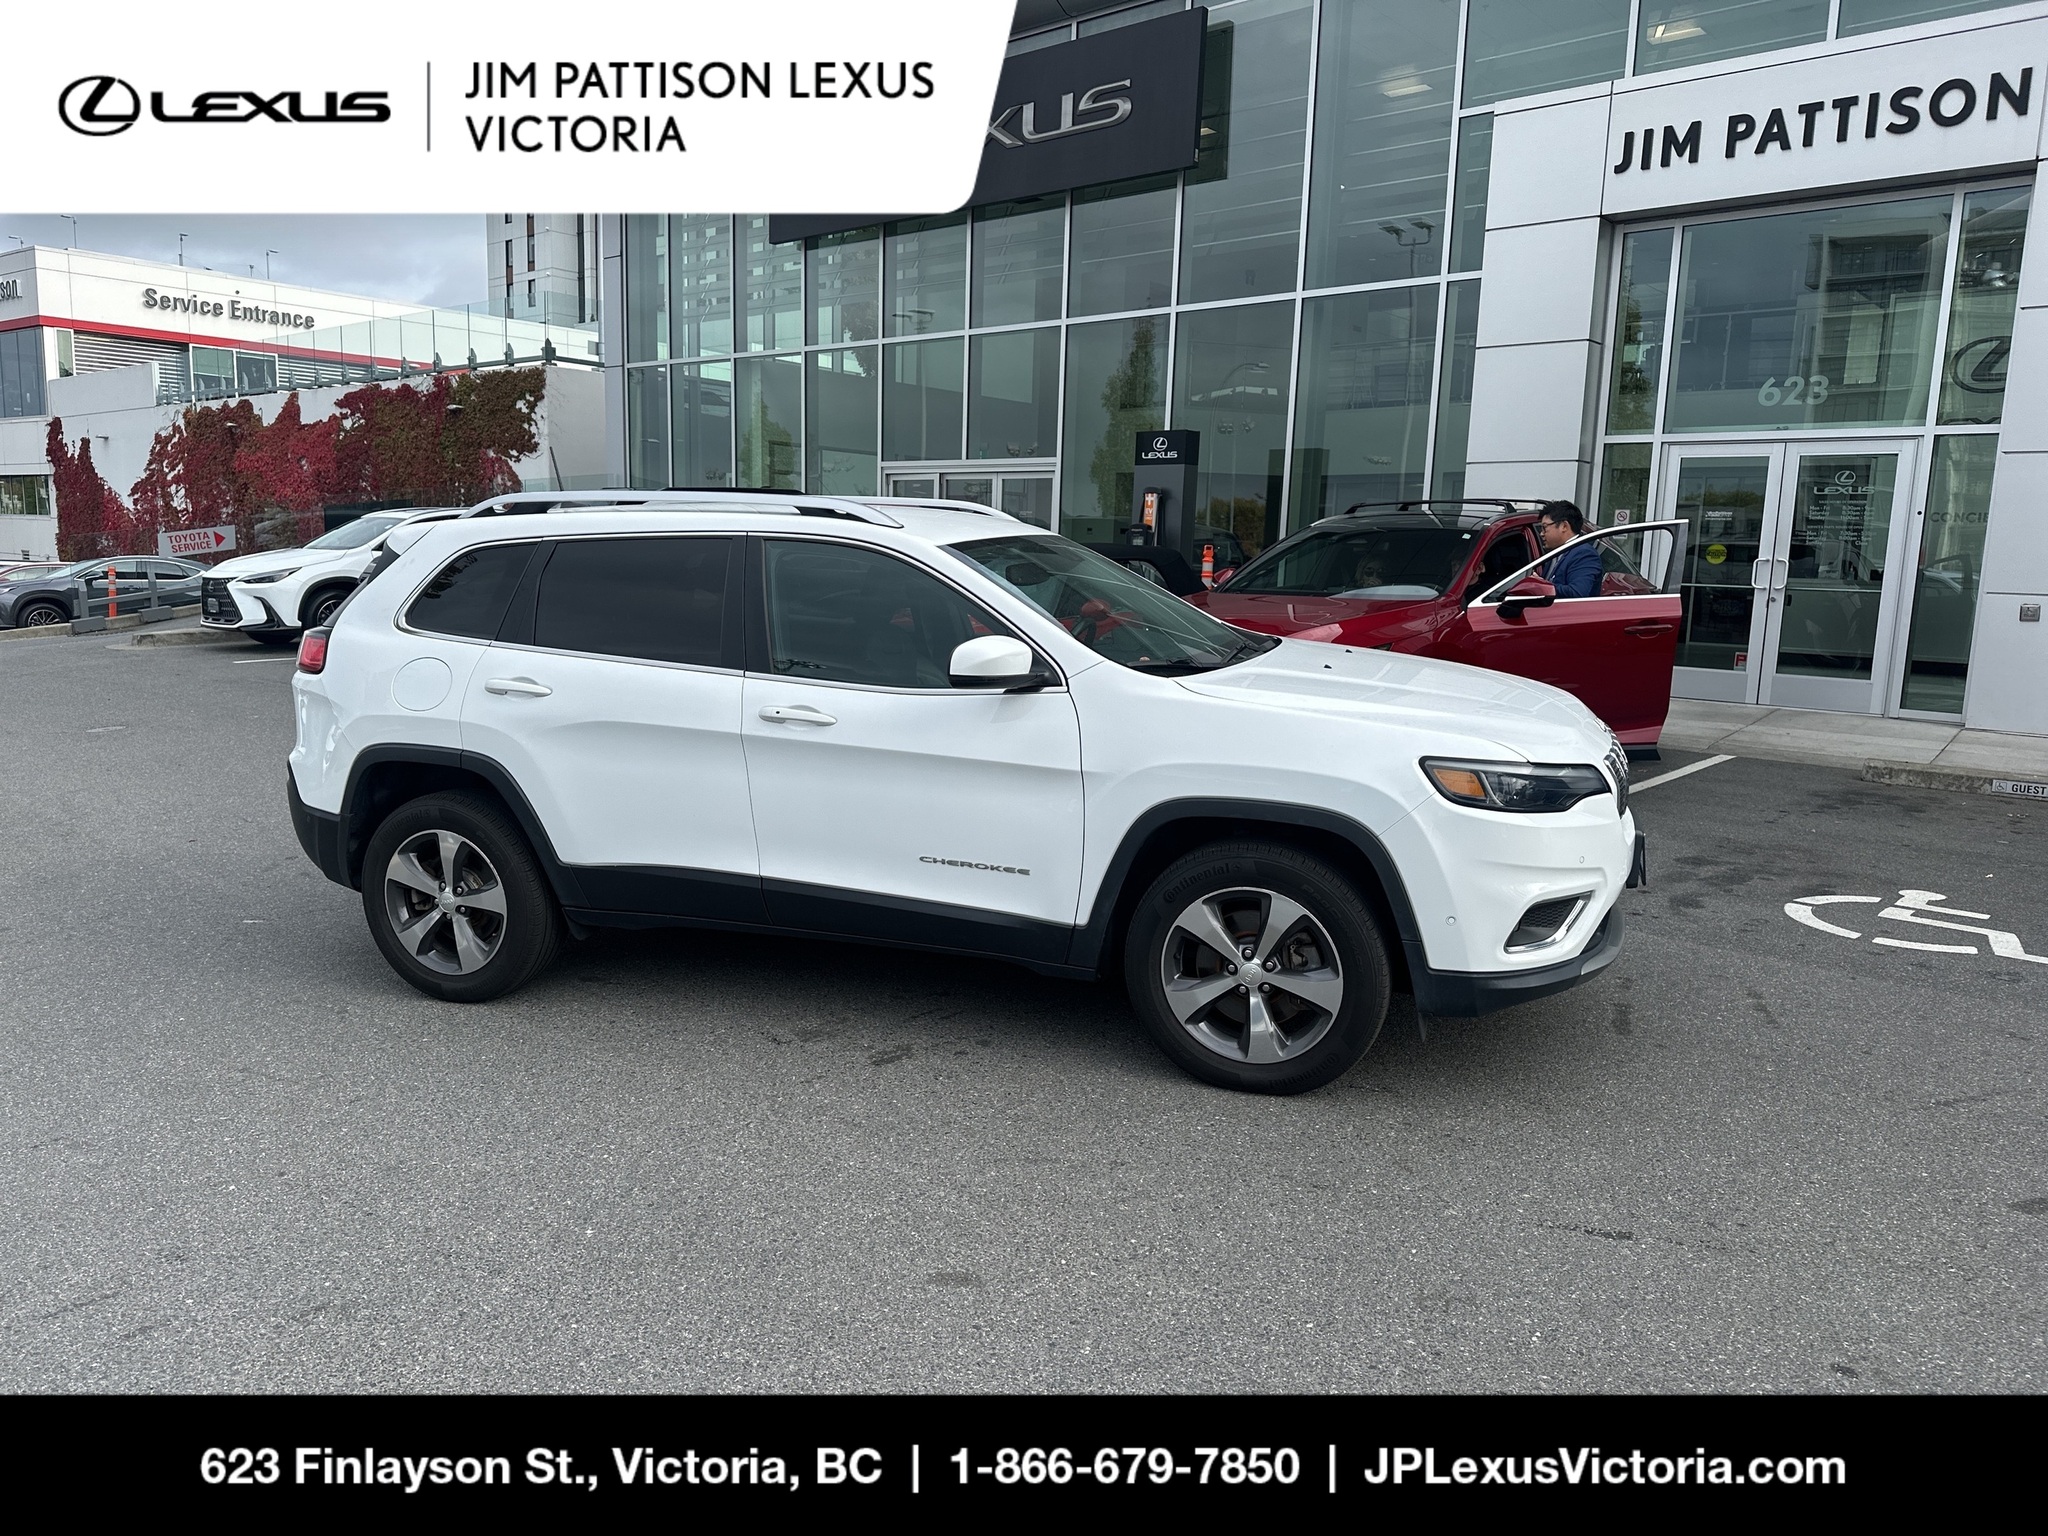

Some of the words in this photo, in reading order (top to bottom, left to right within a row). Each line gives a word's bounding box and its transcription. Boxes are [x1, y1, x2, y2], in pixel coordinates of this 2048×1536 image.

[1613, 120, 1702, 175] JIM
[1725, 66, 2034, 159] PATTISON
[143, 287, 224, 317] Service
[228, 299, 315, 330] Entrance
[1757, 376, 1829, 406] 623
[1141, 450, 1178, 459] LEXUS
[1813, 486, 1875, 495] LEXUS
[167, 531, 210, 544] TOYOTA
[171, 540, 213, 554] SERVICE
[2011, 783, 2047, 796] GUEST
[918, 855, 1031, 876] CHEROKEE
